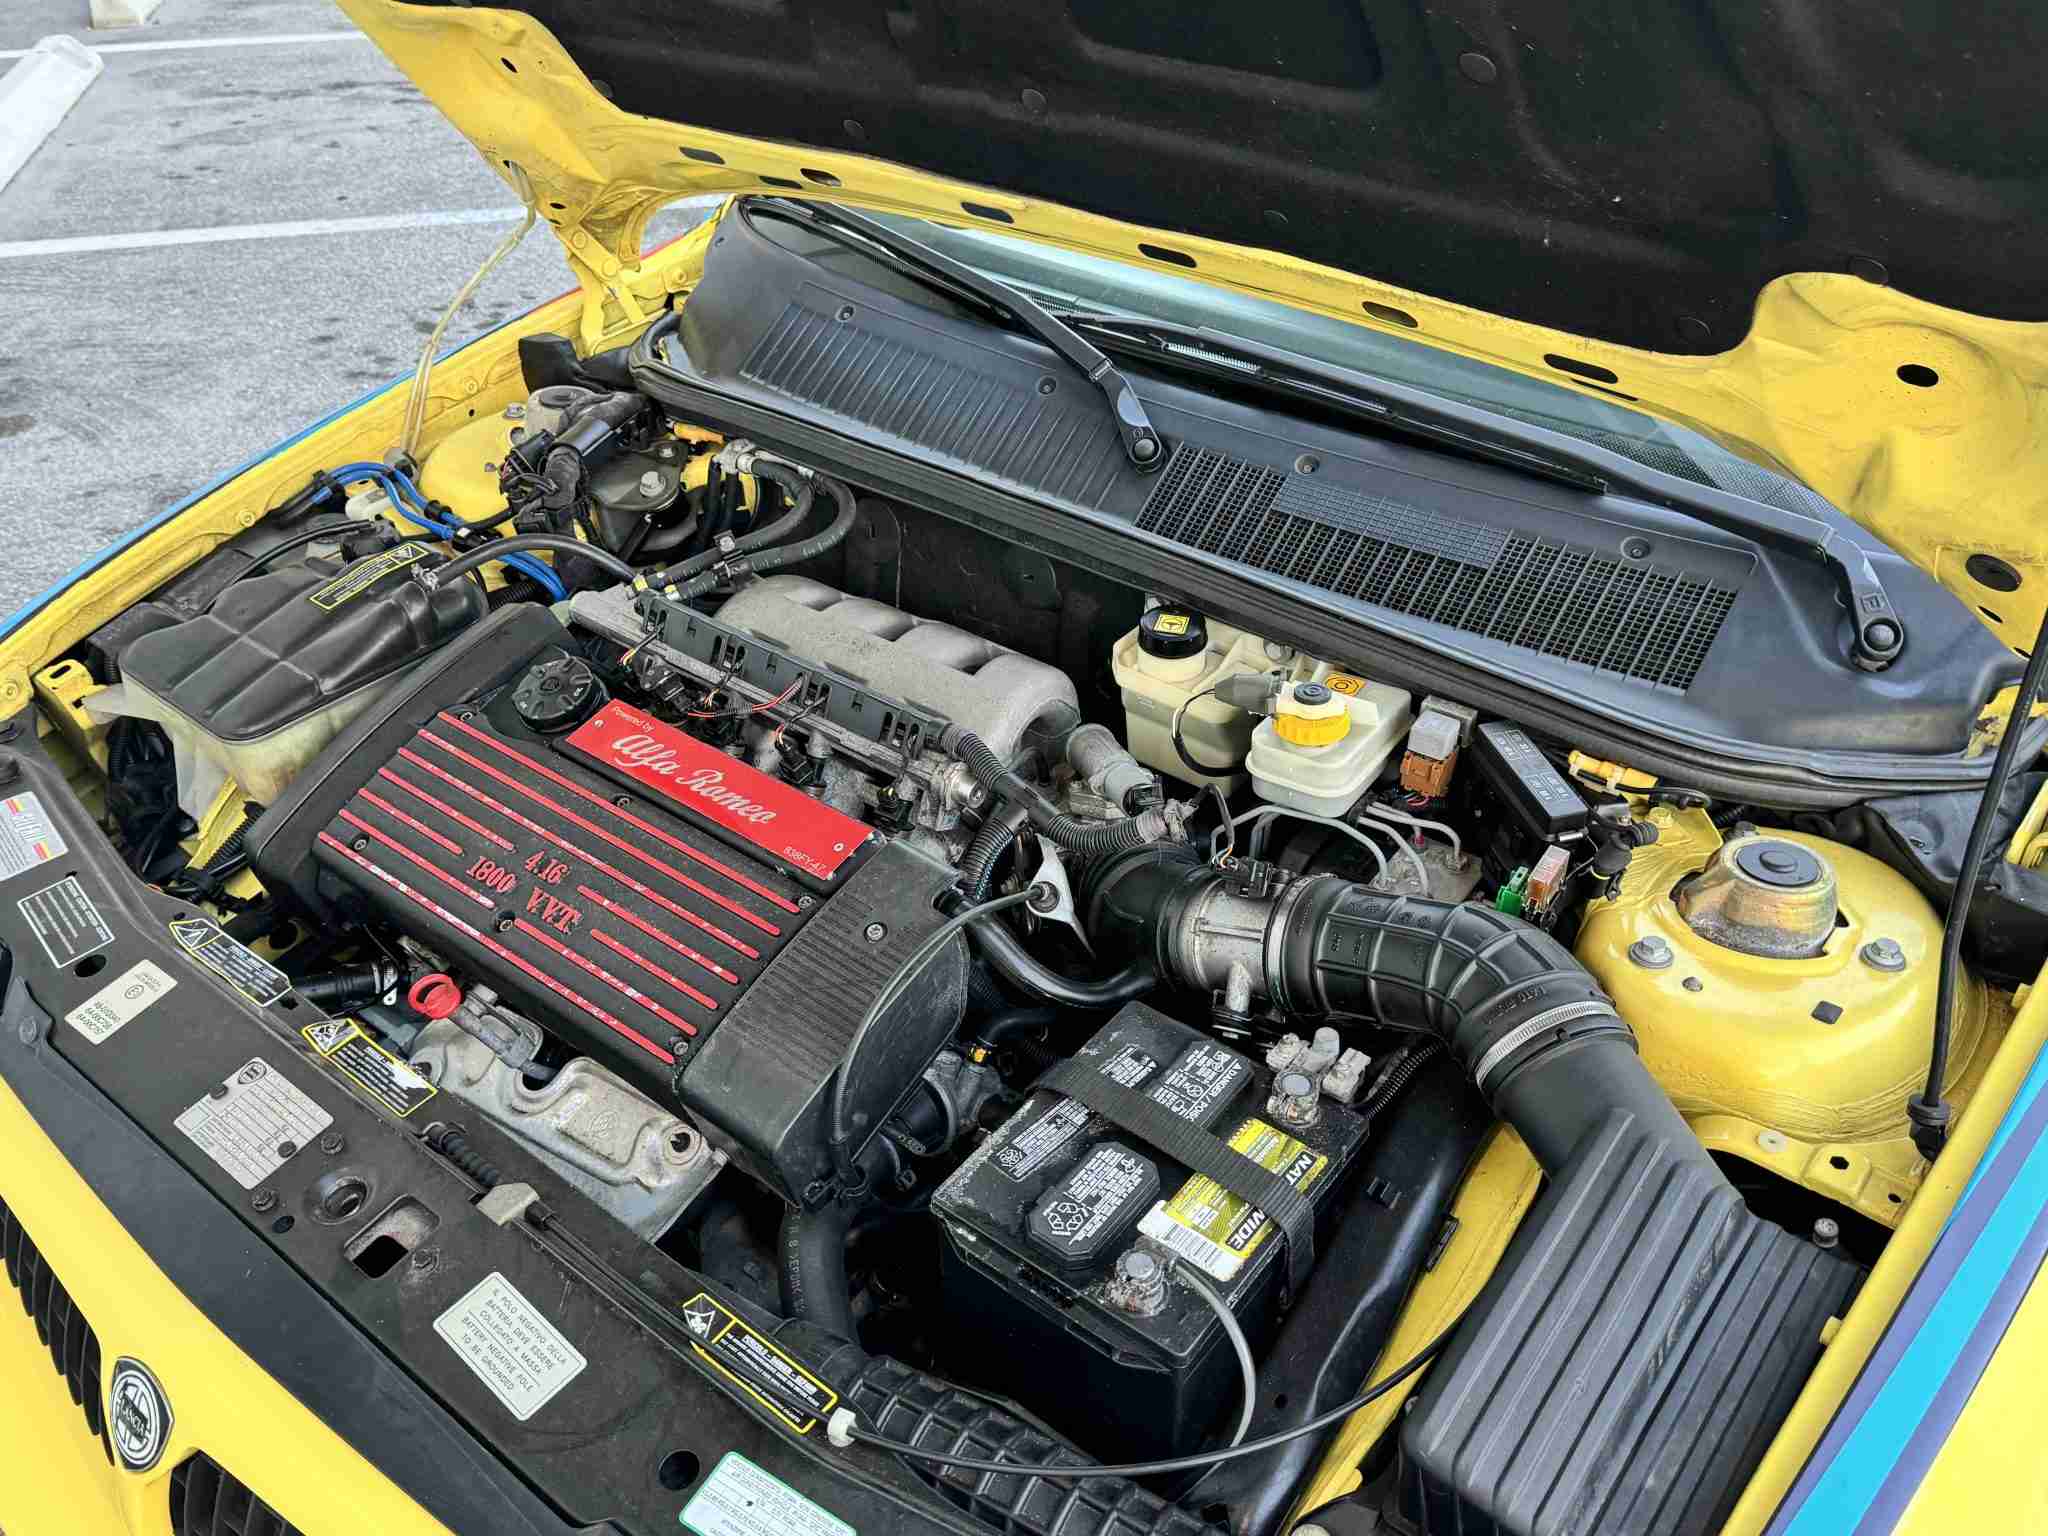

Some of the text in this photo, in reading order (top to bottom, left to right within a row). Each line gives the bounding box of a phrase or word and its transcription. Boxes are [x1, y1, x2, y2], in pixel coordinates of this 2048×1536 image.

[612, 734, 777, 824] Alfa Romeo
[466, 855, 516, 893] 1800
[525, 851, 569, 885] 4.16
[1208, 1069, 1238, 1097] DANGER
[462, 1317, 535, 1393] BATTERY NEGATIVE POLE
[521, 1352, 542, 1375] MASSA
